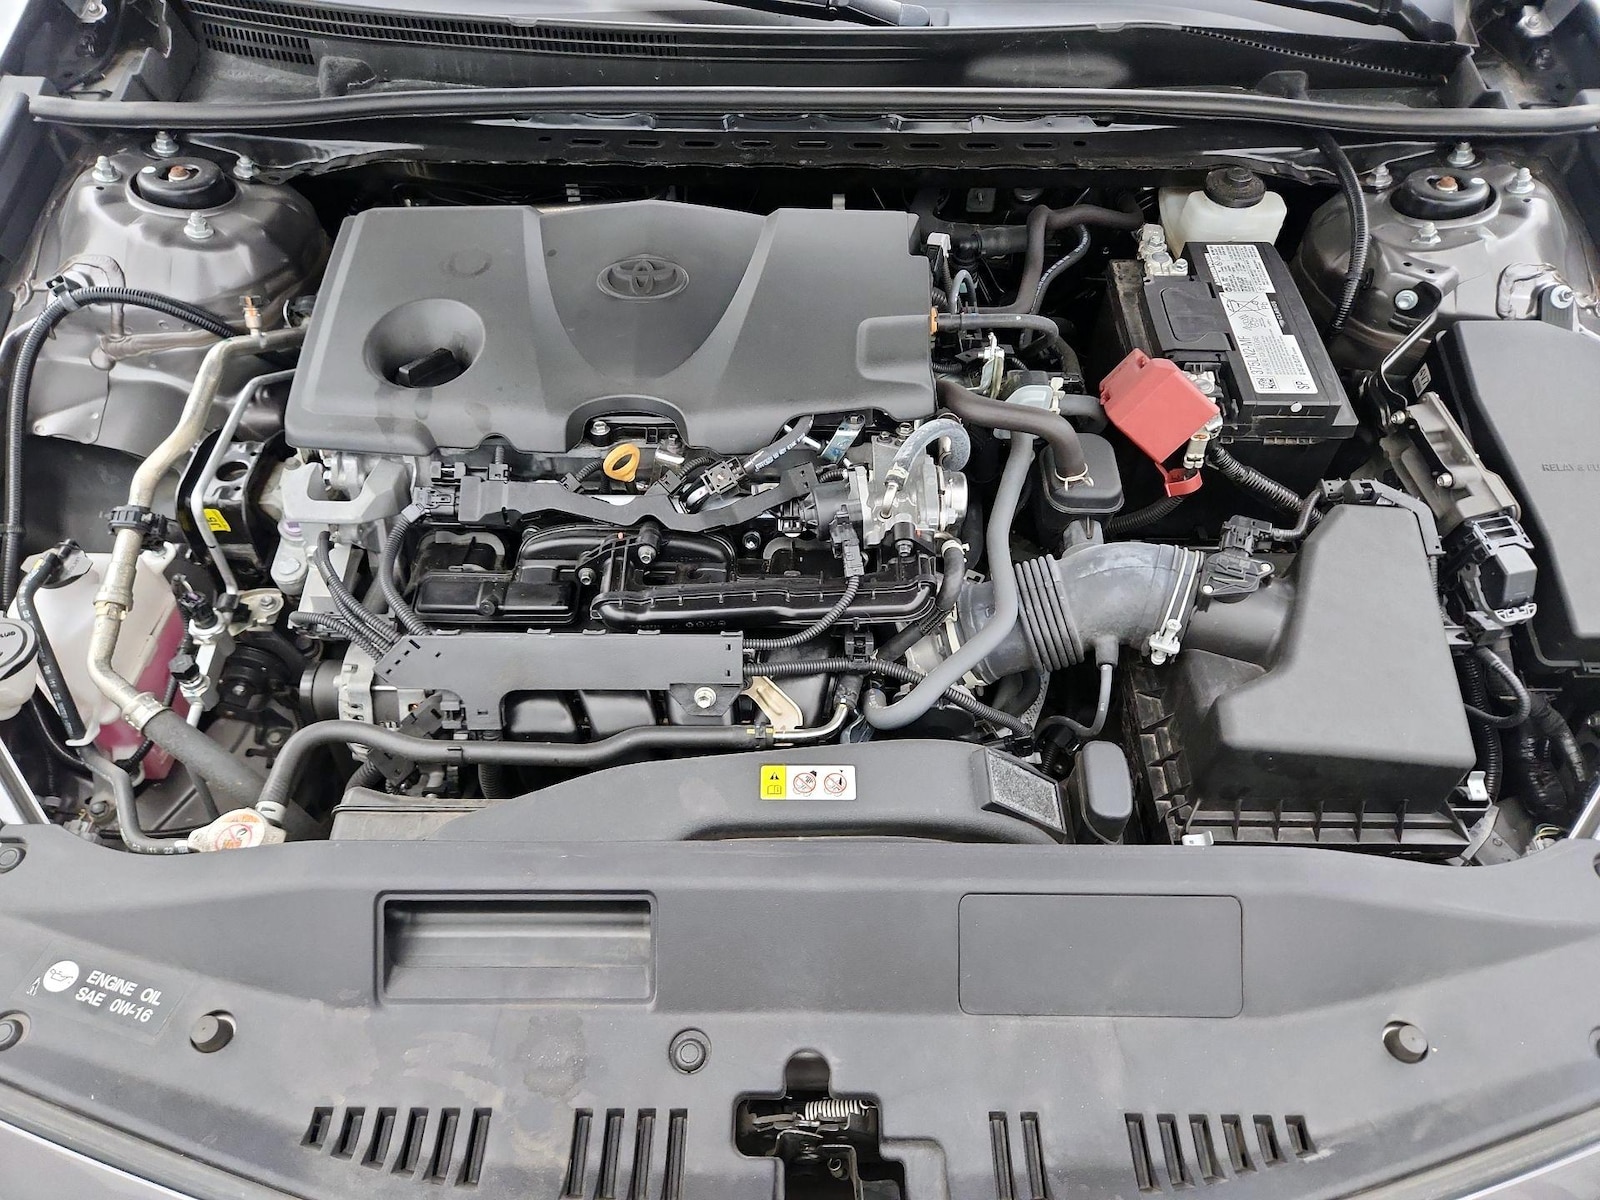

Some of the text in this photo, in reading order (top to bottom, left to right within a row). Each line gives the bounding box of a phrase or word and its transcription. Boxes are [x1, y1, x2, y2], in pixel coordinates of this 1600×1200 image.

[1541, 463, 1575, 472] RELAY
[75, 987, 153, 1023] SAE 0W-16
[86, 970, 163, 1006] ENGINE OIL
